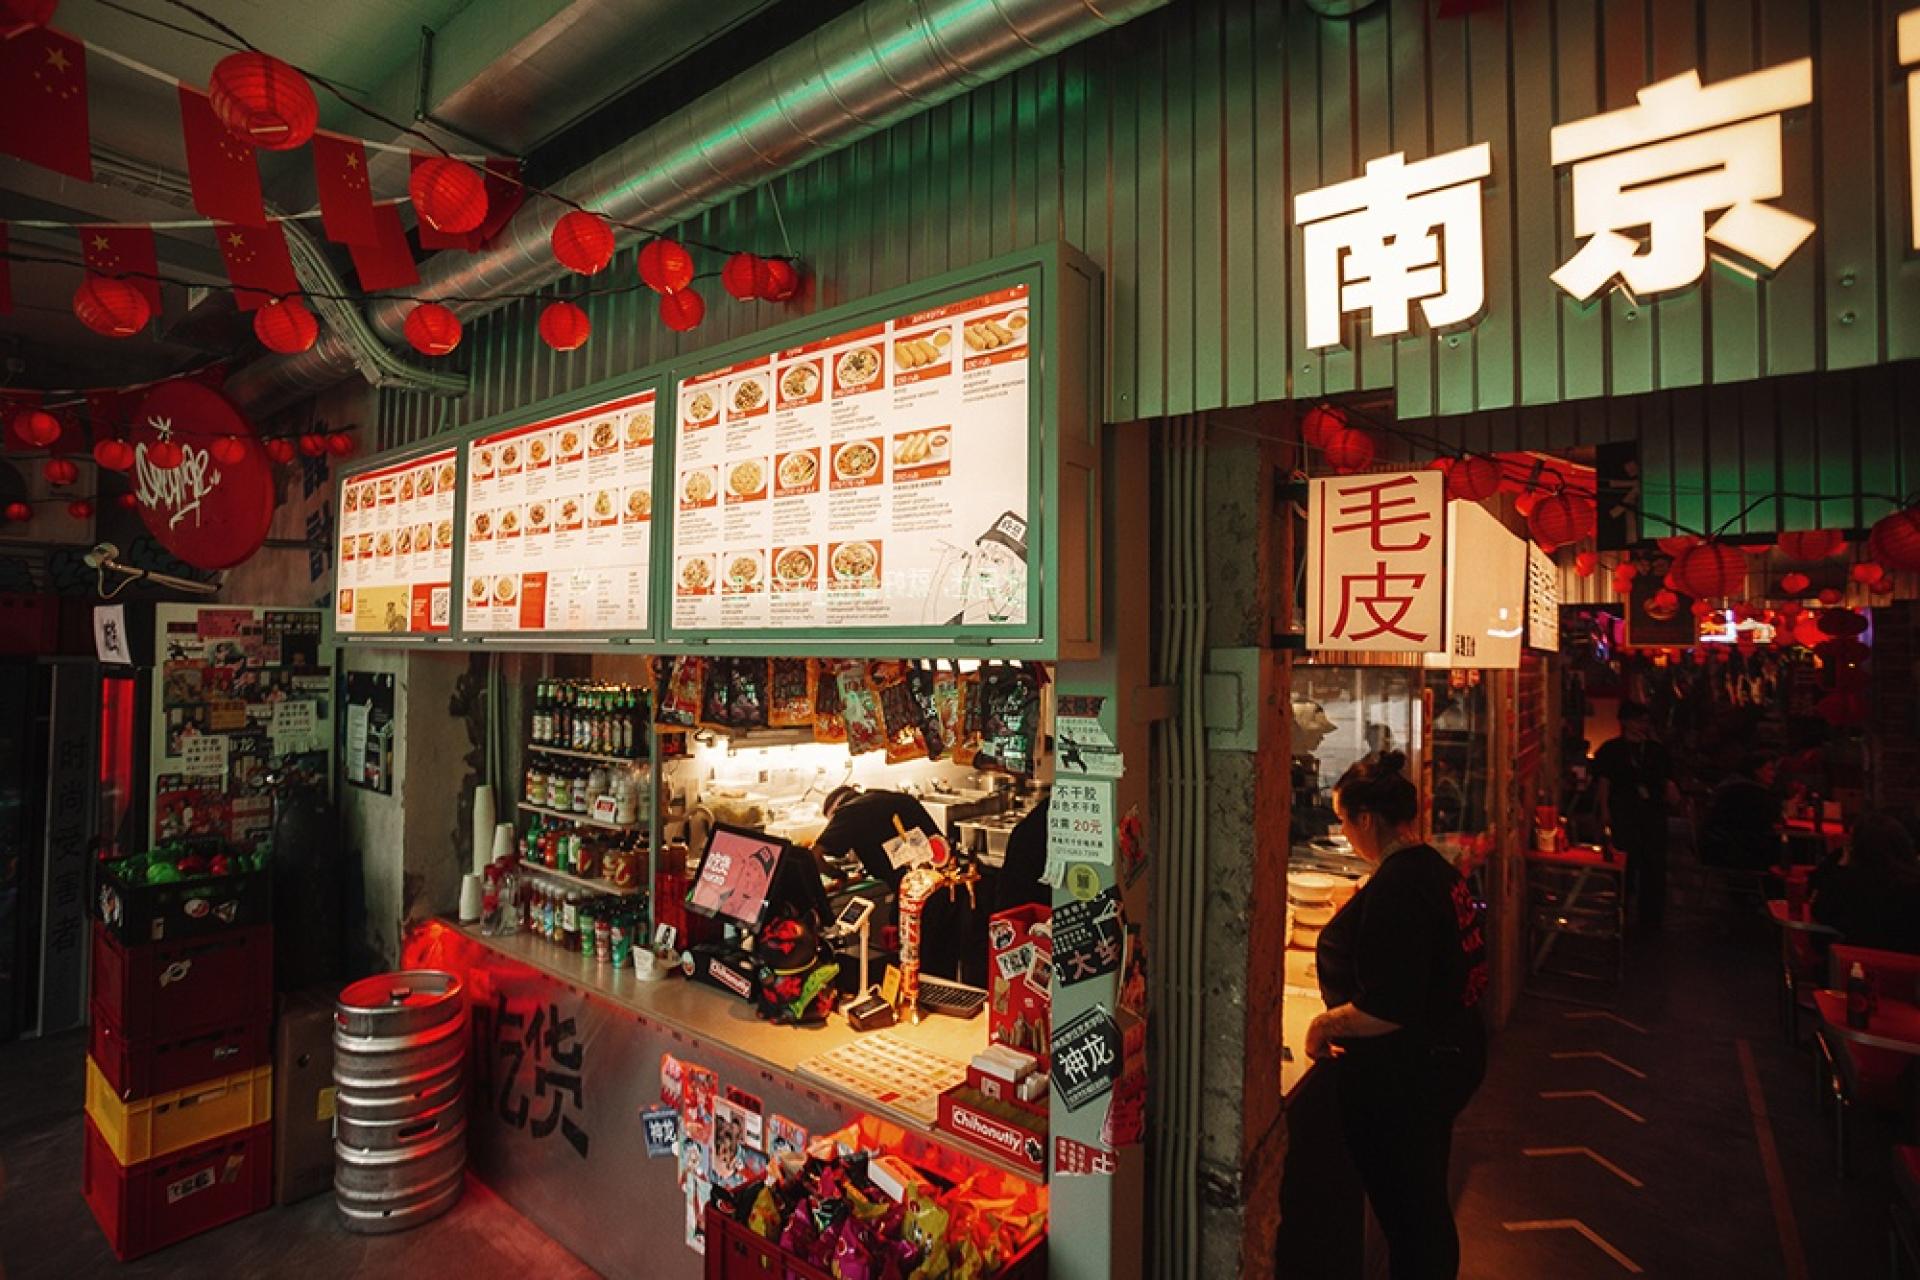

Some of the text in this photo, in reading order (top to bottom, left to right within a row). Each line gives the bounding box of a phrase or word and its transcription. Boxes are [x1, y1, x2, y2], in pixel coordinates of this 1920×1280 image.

[1294, 10, 1920, 350] 南京
[1330, 474, 1432, 642] 毛皮
[1057, 1033, 1115, 1085] 神龙
